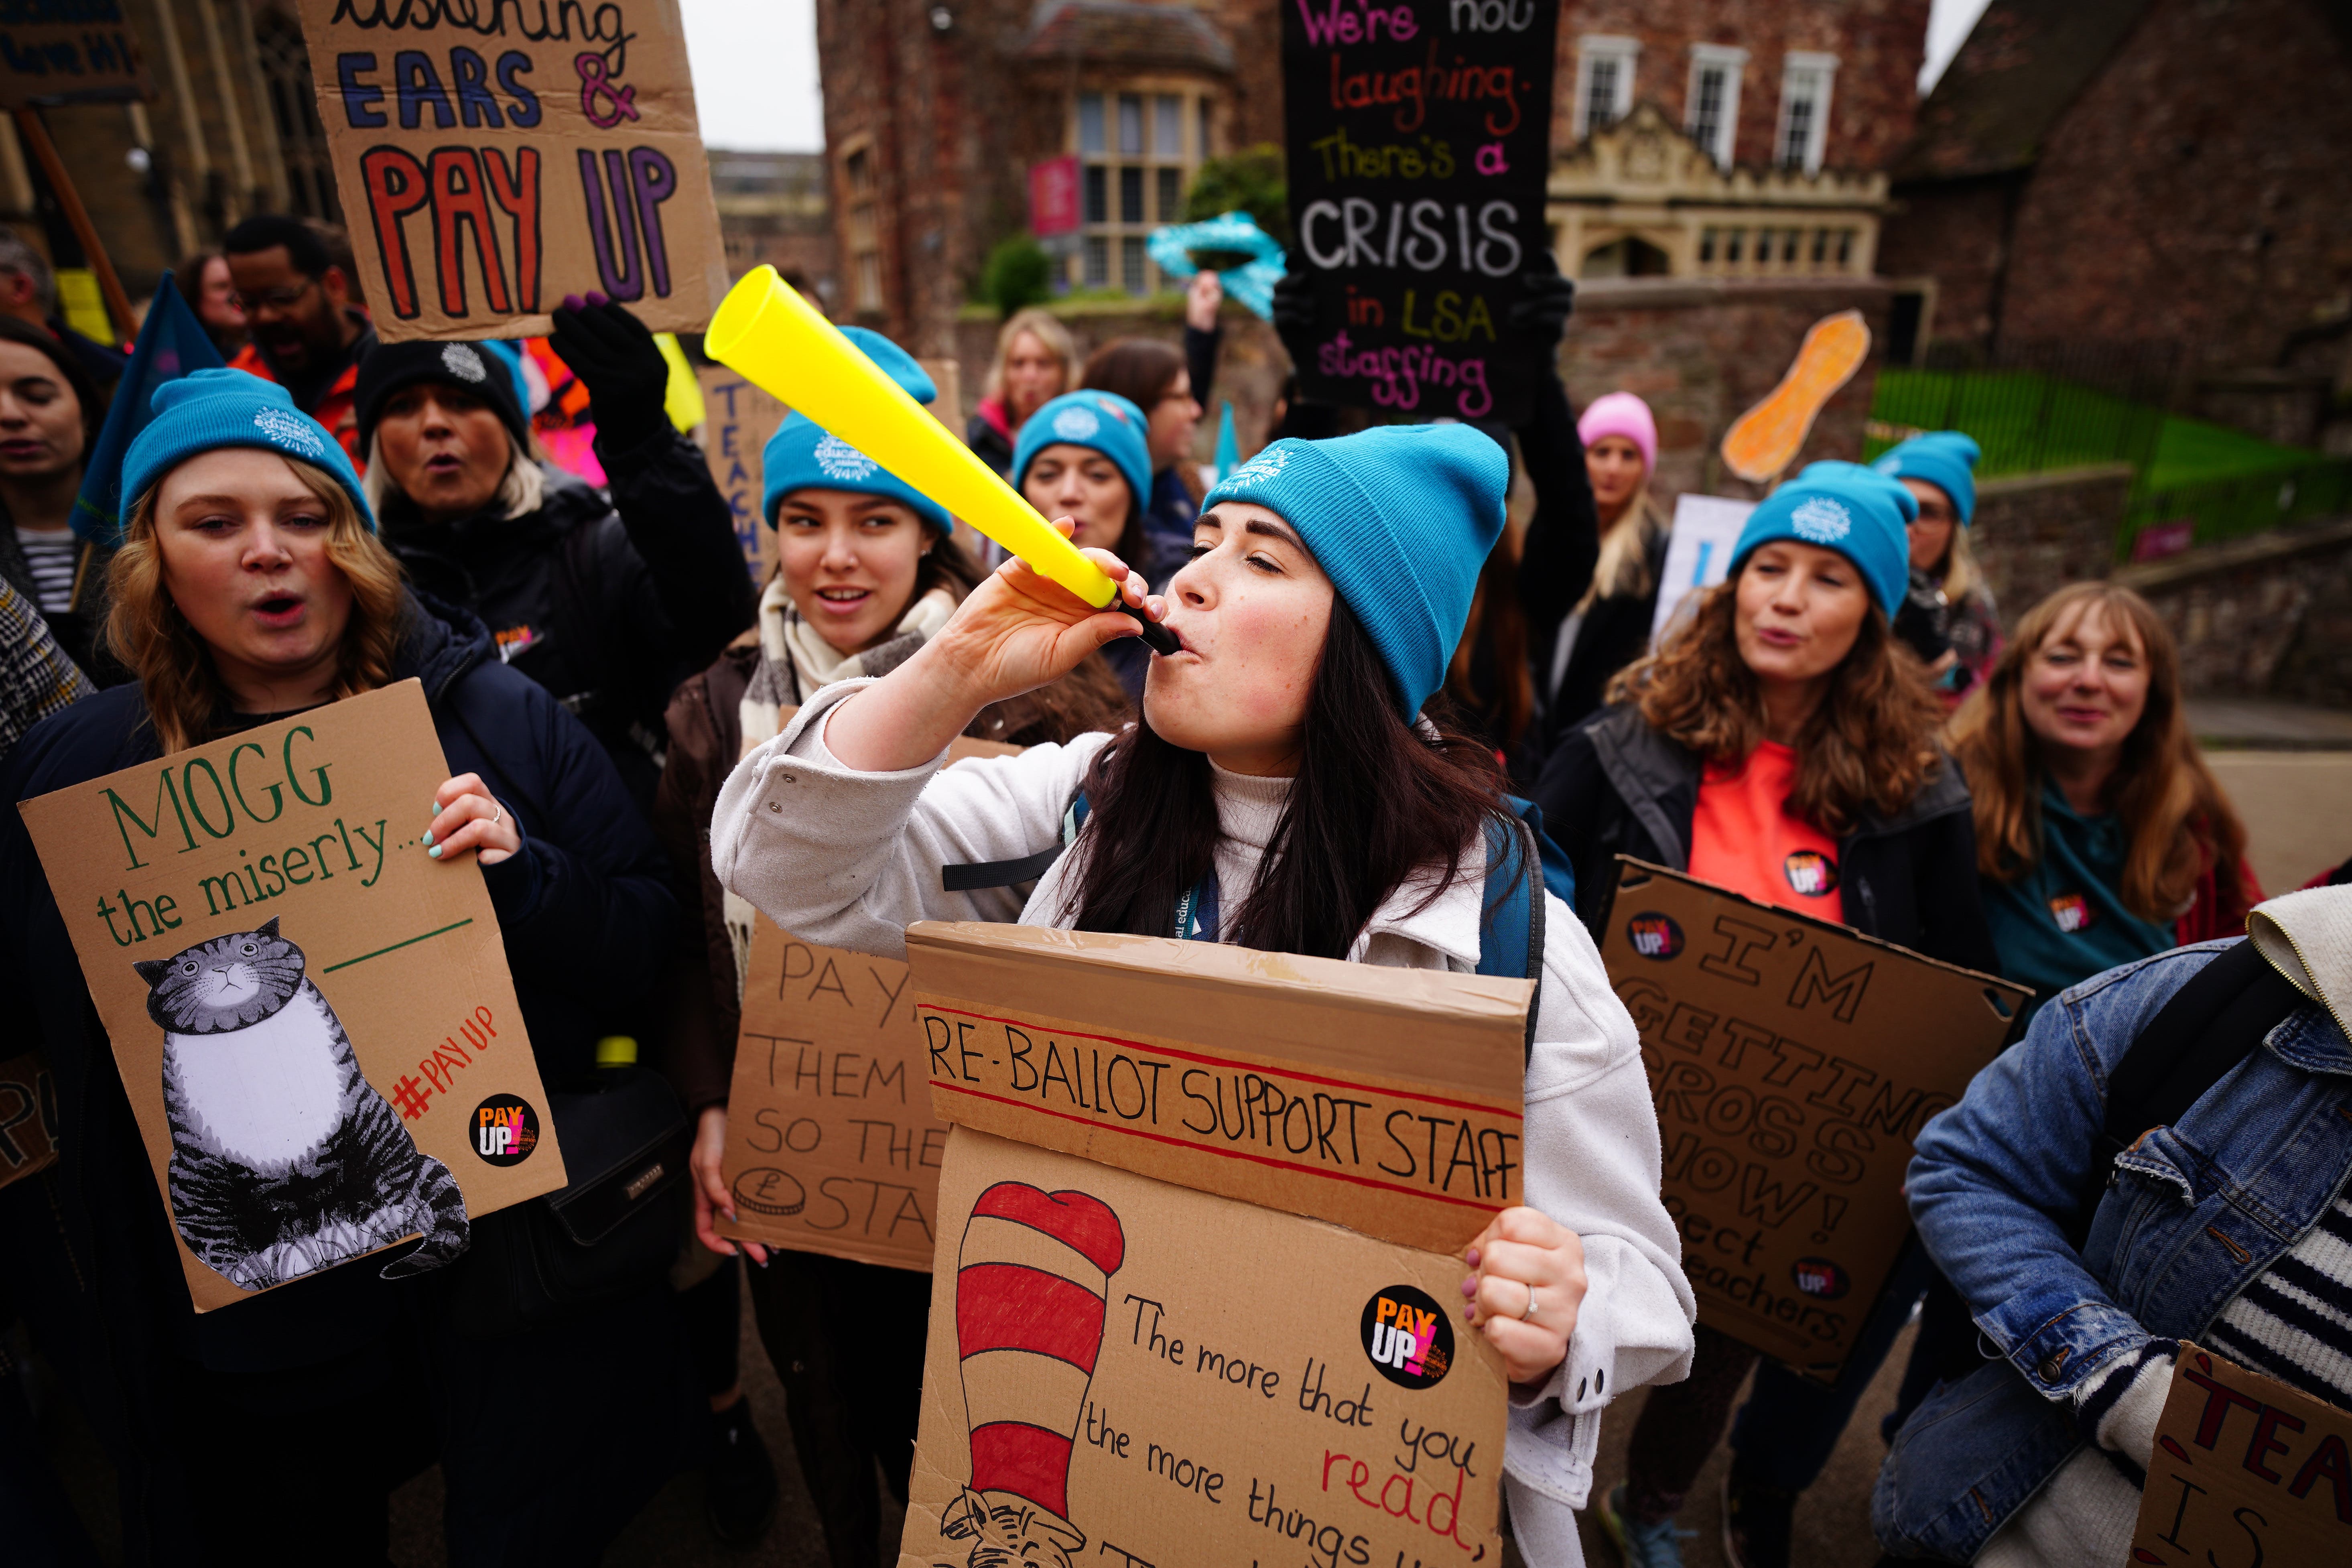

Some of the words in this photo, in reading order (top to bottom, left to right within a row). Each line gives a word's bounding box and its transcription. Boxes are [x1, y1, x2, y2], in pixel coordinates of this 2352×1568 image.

[337, 46, 541, 129] EARS
[574, 52, 640, 129] &
[1310, 127, 1455, 183] There's
[1474, 141, 1510, 175] a
[360, 145, 541, 320] PAY
[577, 145, 677, 302] UP
[1300, 197, 1521, 277] CRISIS
[1346, 284, 1384, 326] in
[1401, 288, 1497, 342] LSA
[1318, 330, 1492, 417] staffing
[98, 726, 333, 870] MOGG
[97, 889, 183, 947] the
[1700, 915, 1874, 1024] I'M
[743, 1033, 906, 1104] THEM
[924, 1016, 1171, 1125] RE-BALLOT
[1181, 1069, 1372, 1165] SUPPORT
[1378, 1110, 1519, 1200] STAFF
[479, 1106, 523, 1127] PAY
[480, 1114, 524, 1155] UP!
[746, 1108, 821, 1152] SO
[1371, 1319, 1437, 1376] UP!
[1376, 1296, 1437, 1338] PAY
[1124, 1294, 1183, 1365] The
[1197, 1345, 1279, 1398] more
[1300, 1357, 1374, 1427] that
[1395, 1418, 1476, 1477] you
[1087, 1401, 1129, 1458] the
[1148, 1443, 1223, 1504] more
[1249, 1478, 1370, 1568] things
[2183, 1367, 2352, 1525] TEA
[2157, 1474, 2268, 1568] IS
